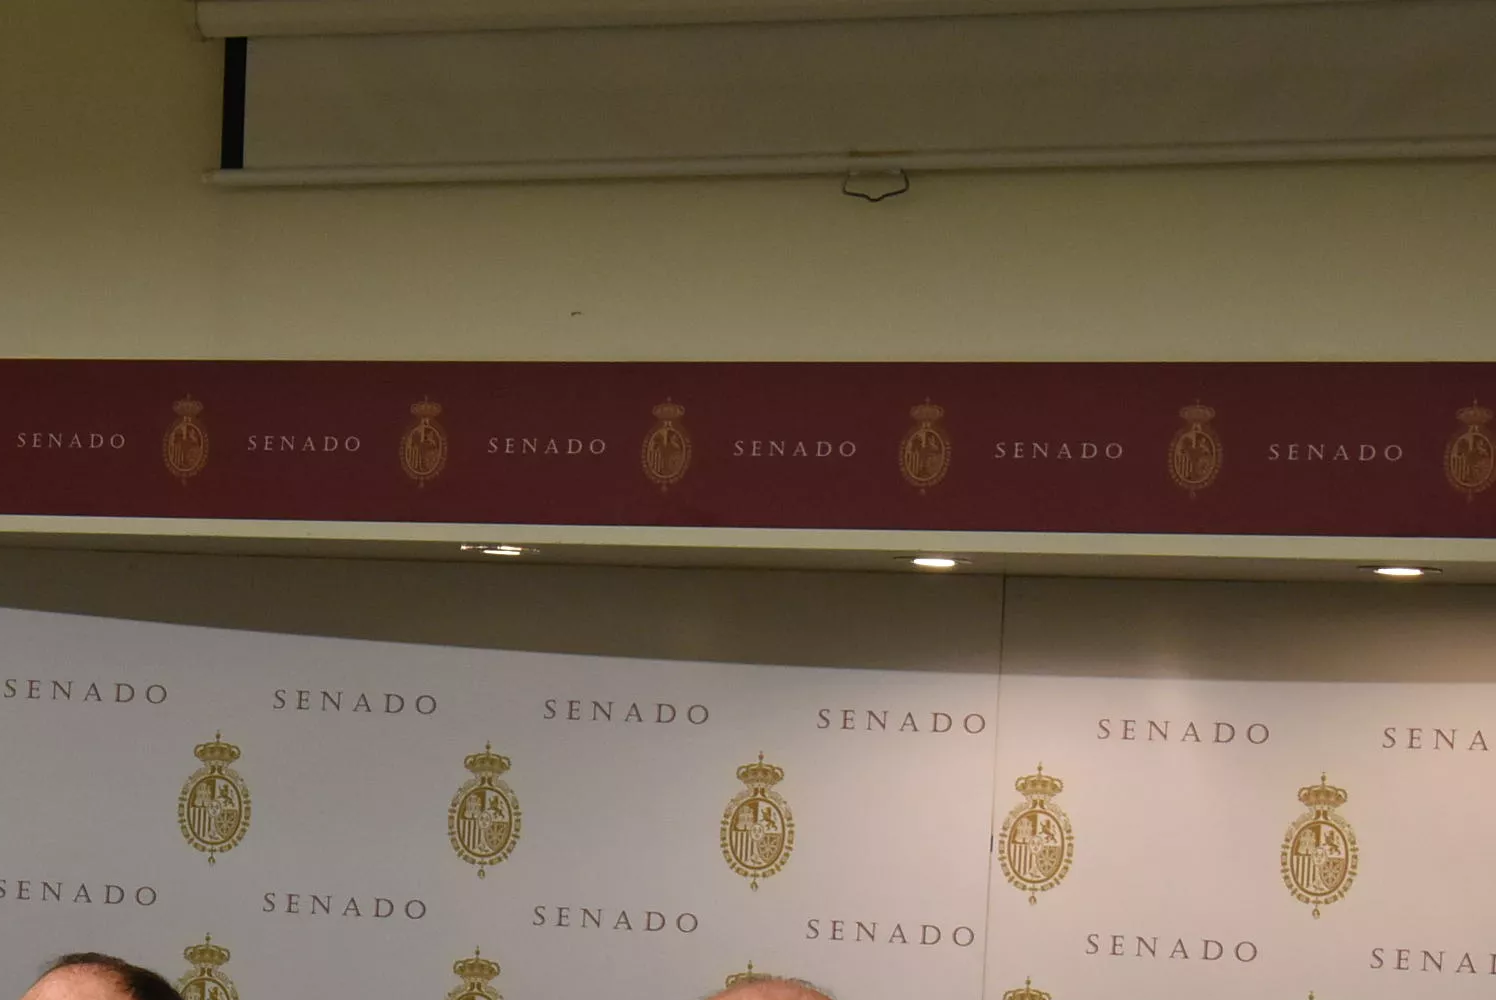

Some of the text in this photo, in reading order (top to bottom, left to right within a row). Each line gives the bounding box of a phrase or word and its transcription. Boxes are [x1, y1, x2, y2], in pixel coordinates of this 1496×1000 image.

[15, 432, 126, 450] SENADO
[246, 435, 361, 452] SENADO
[486, 437, 606, 455] SENADO
[732, 440, 857, 457] SENADO
[993, 441, 1123, 460] SENADO
[1267, 443, 1403, 462] SENADO
[4, 679, 167, 704] SENADO
[273, 689, 436, 714] SENADO
[544, 699, 708, 725] SENADO
[817, 709, 985, 734] SENADO
[1098, 719, 1269, 744] SENADO
[1382, 727, 1489, 751] SENA
[263, 893, 426, 919] SENADO
[533, 906, 698, 933] SENADO
[807, 919, 974, 947] SENADO
[1086, 934, 1257, 962] SENADO
